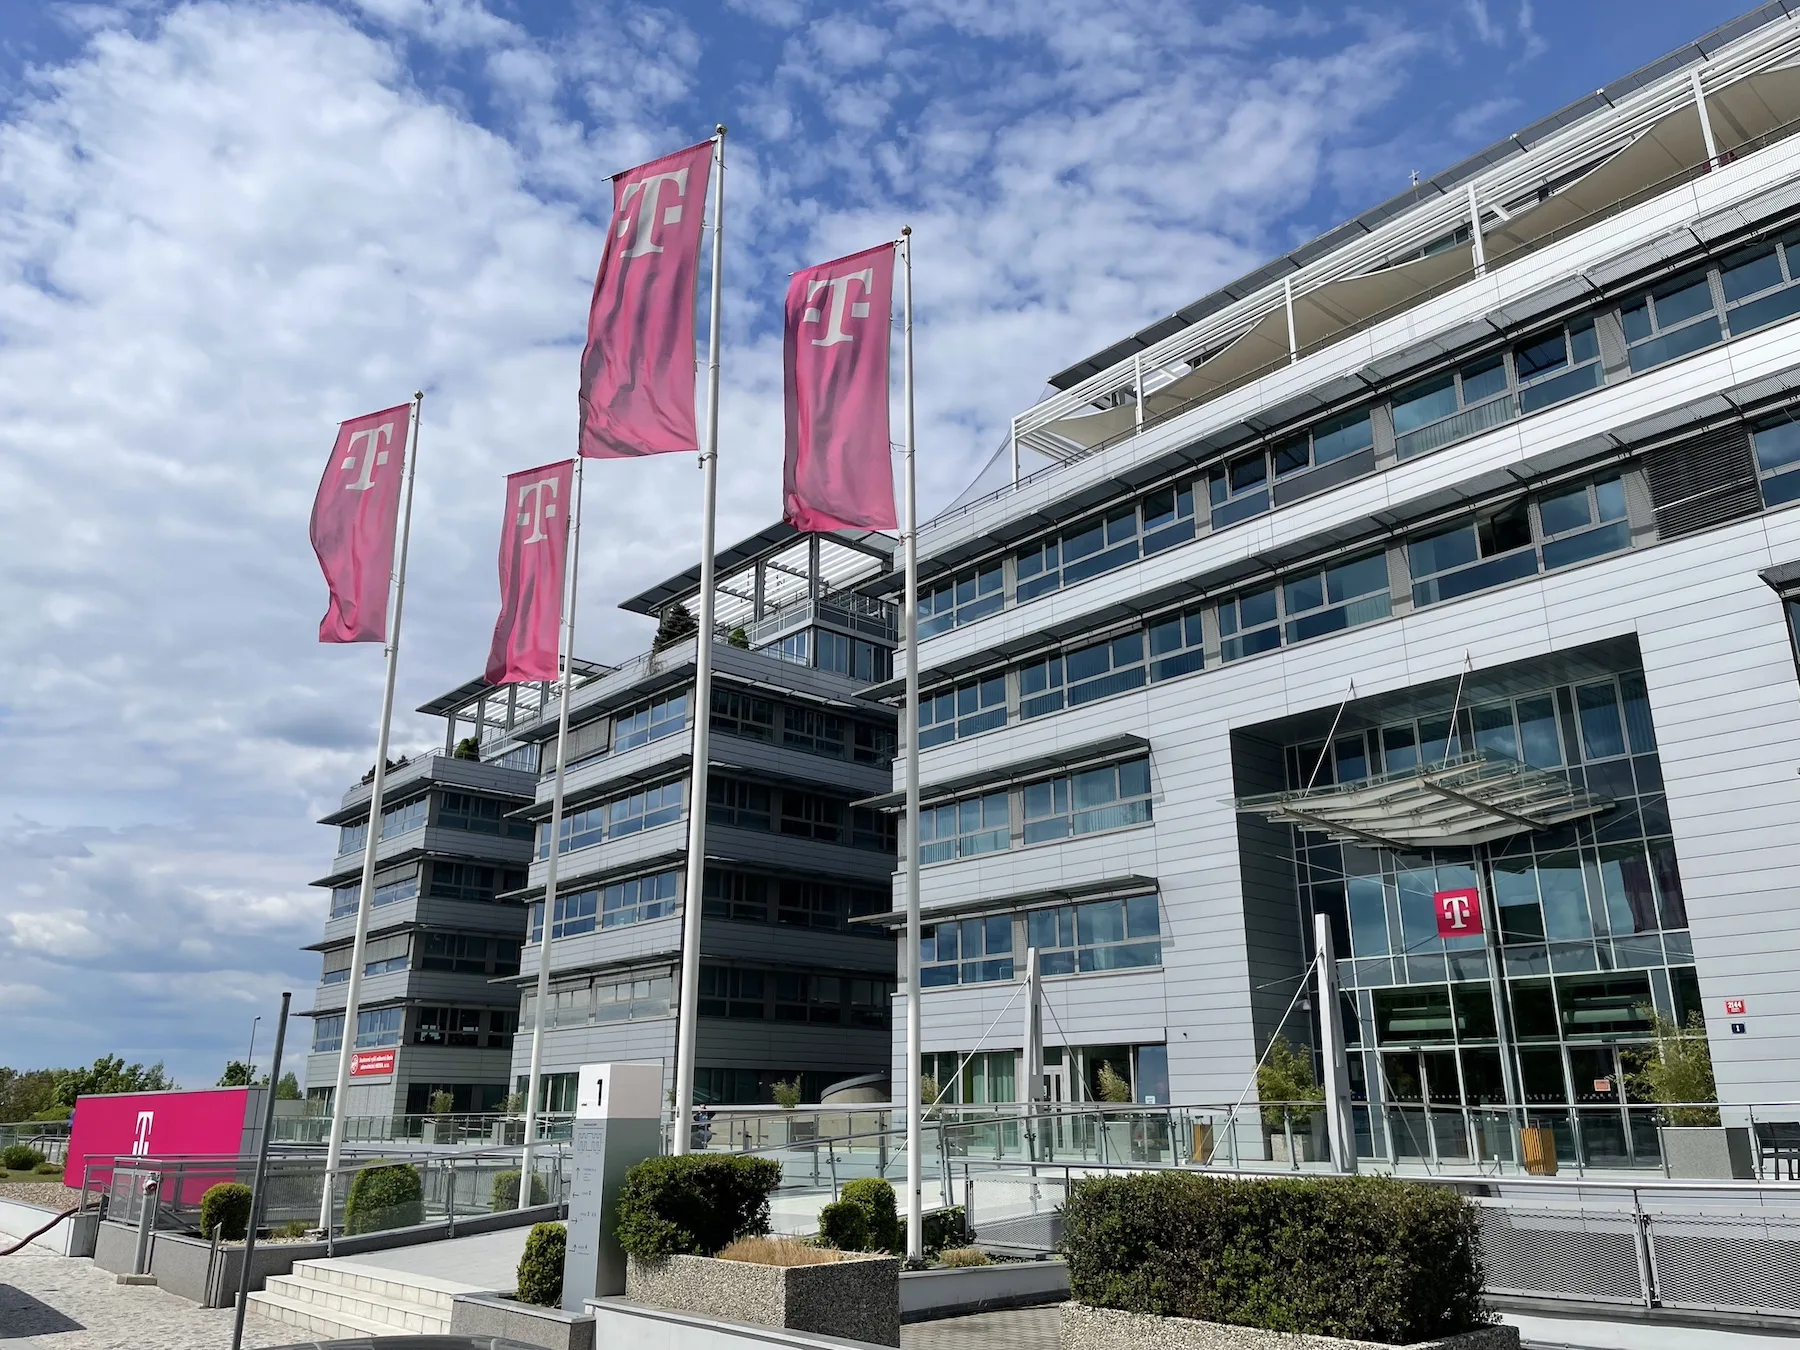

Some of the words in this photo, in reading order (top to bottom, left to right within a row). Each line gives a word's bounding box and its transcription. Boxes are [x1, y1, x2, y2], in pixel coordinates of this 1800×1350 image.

[617, 168, 689, 258] T
[803, 268, 873, 347] T
[341, 422, 394, 491] T
[516, 477, 559, 544] T
[1443, 896, 1470, 928] T
[597, 1078, 603, 1106] 1
[132, 1111, 154, 1155] T
